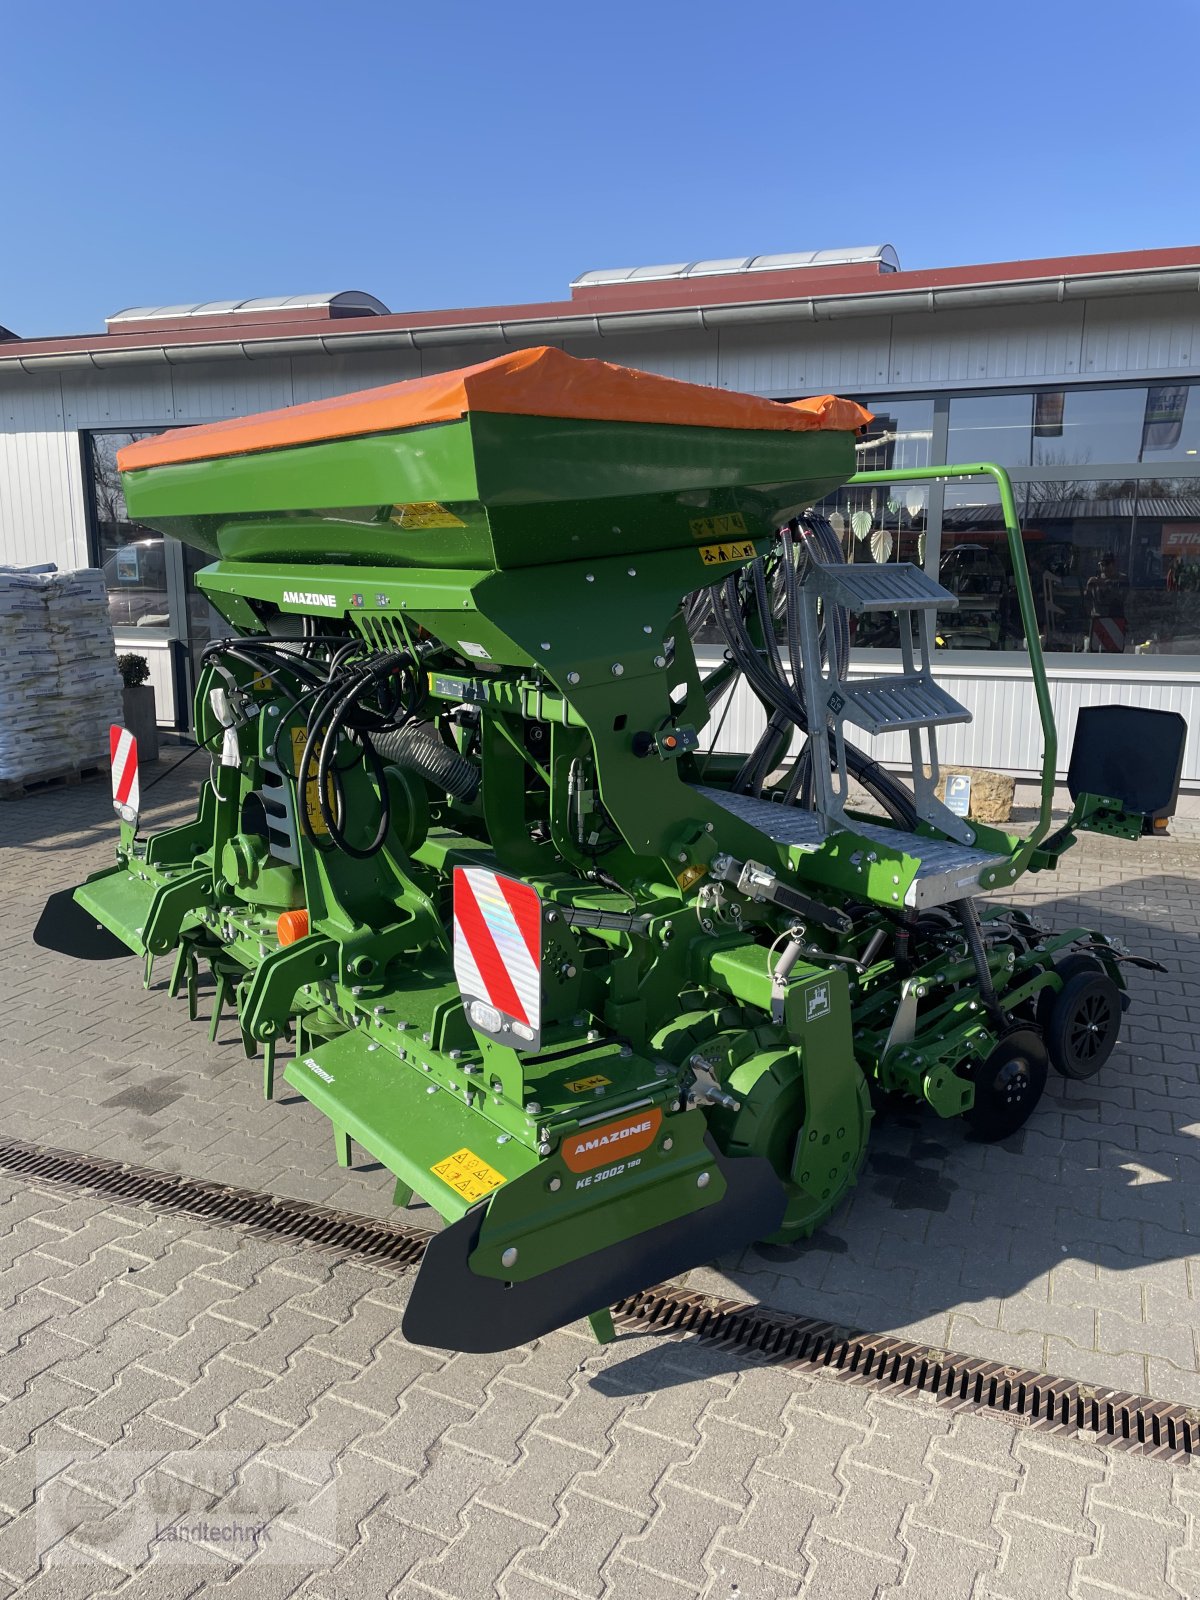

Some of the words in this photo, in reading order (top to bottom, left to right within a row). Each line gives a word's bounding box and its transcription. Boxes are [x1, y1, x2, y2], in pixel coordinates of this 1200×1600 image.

[283, 591, 337, 608] AMAZONE
[950, 777, 966, 796] P
[574, 1121, 651, 1155] AMAZONE
[576, 1177, 592, 1189] KE
[594, 1165, 624, 1183] 3002
